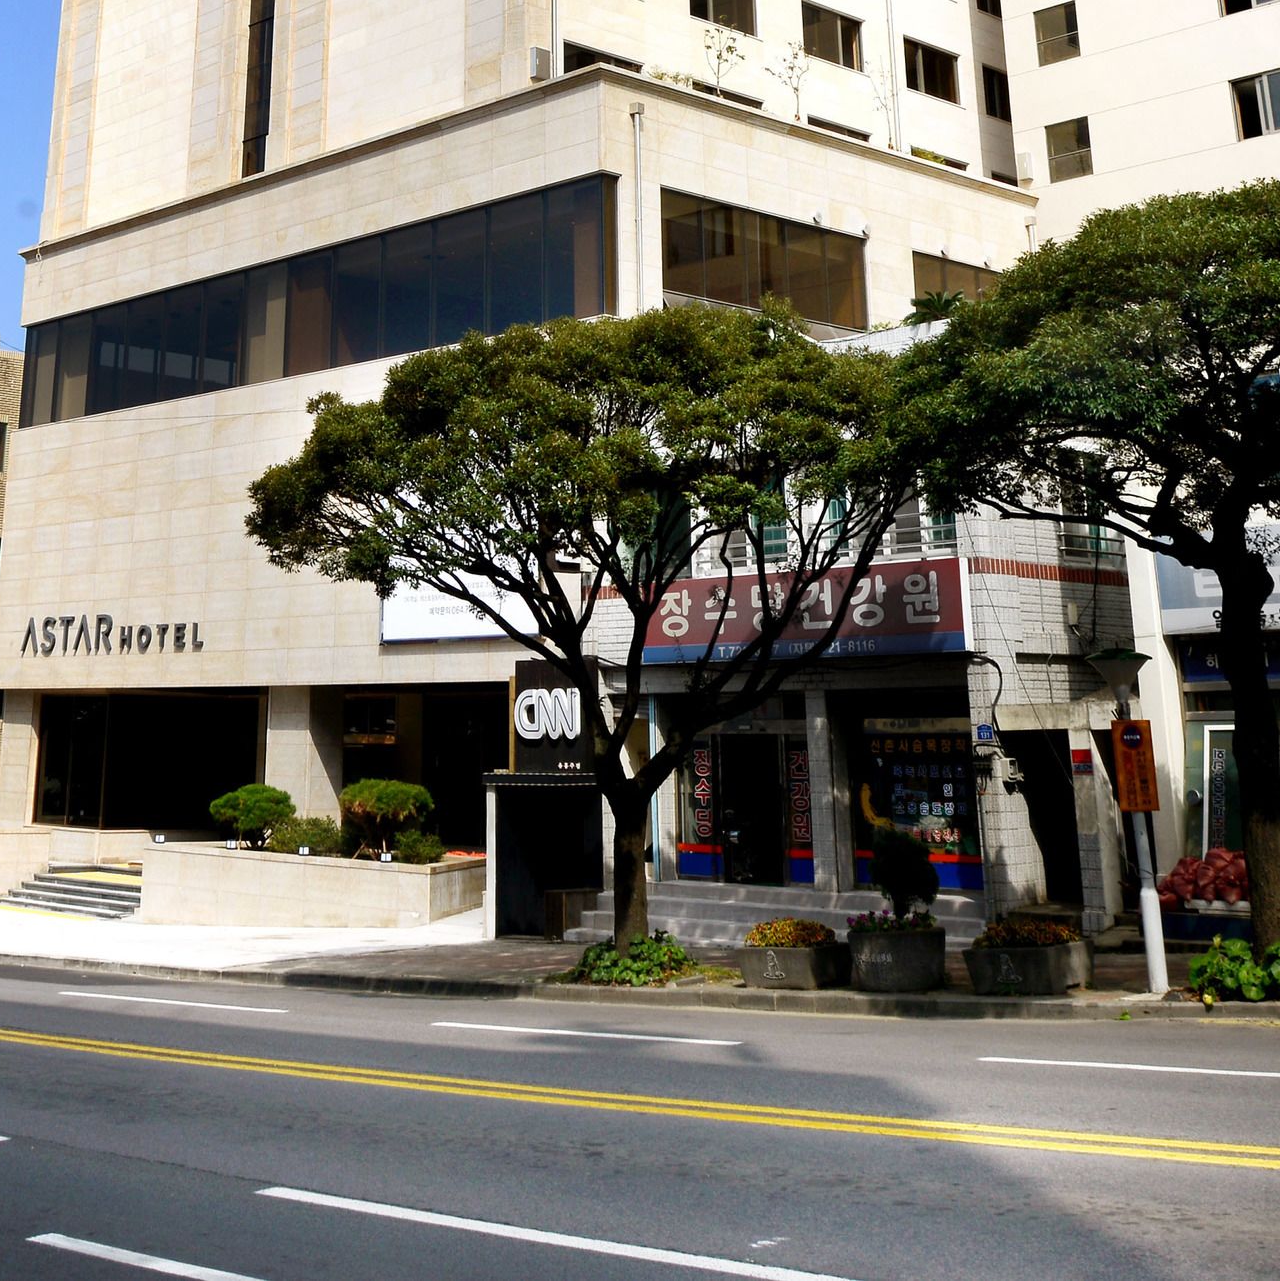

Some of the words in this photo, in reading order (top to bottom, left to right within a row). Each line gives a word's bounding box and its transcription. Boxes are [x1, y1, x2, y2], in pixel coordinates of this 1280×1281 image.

[20, 614, 114, 658] ASTAR
[119, 622, 205, 655] HOTEL
[514, 687, 581, 740] CNN
[693, 749, 713, 837] 장수당
[788, 749, 812, 843] 건강원
